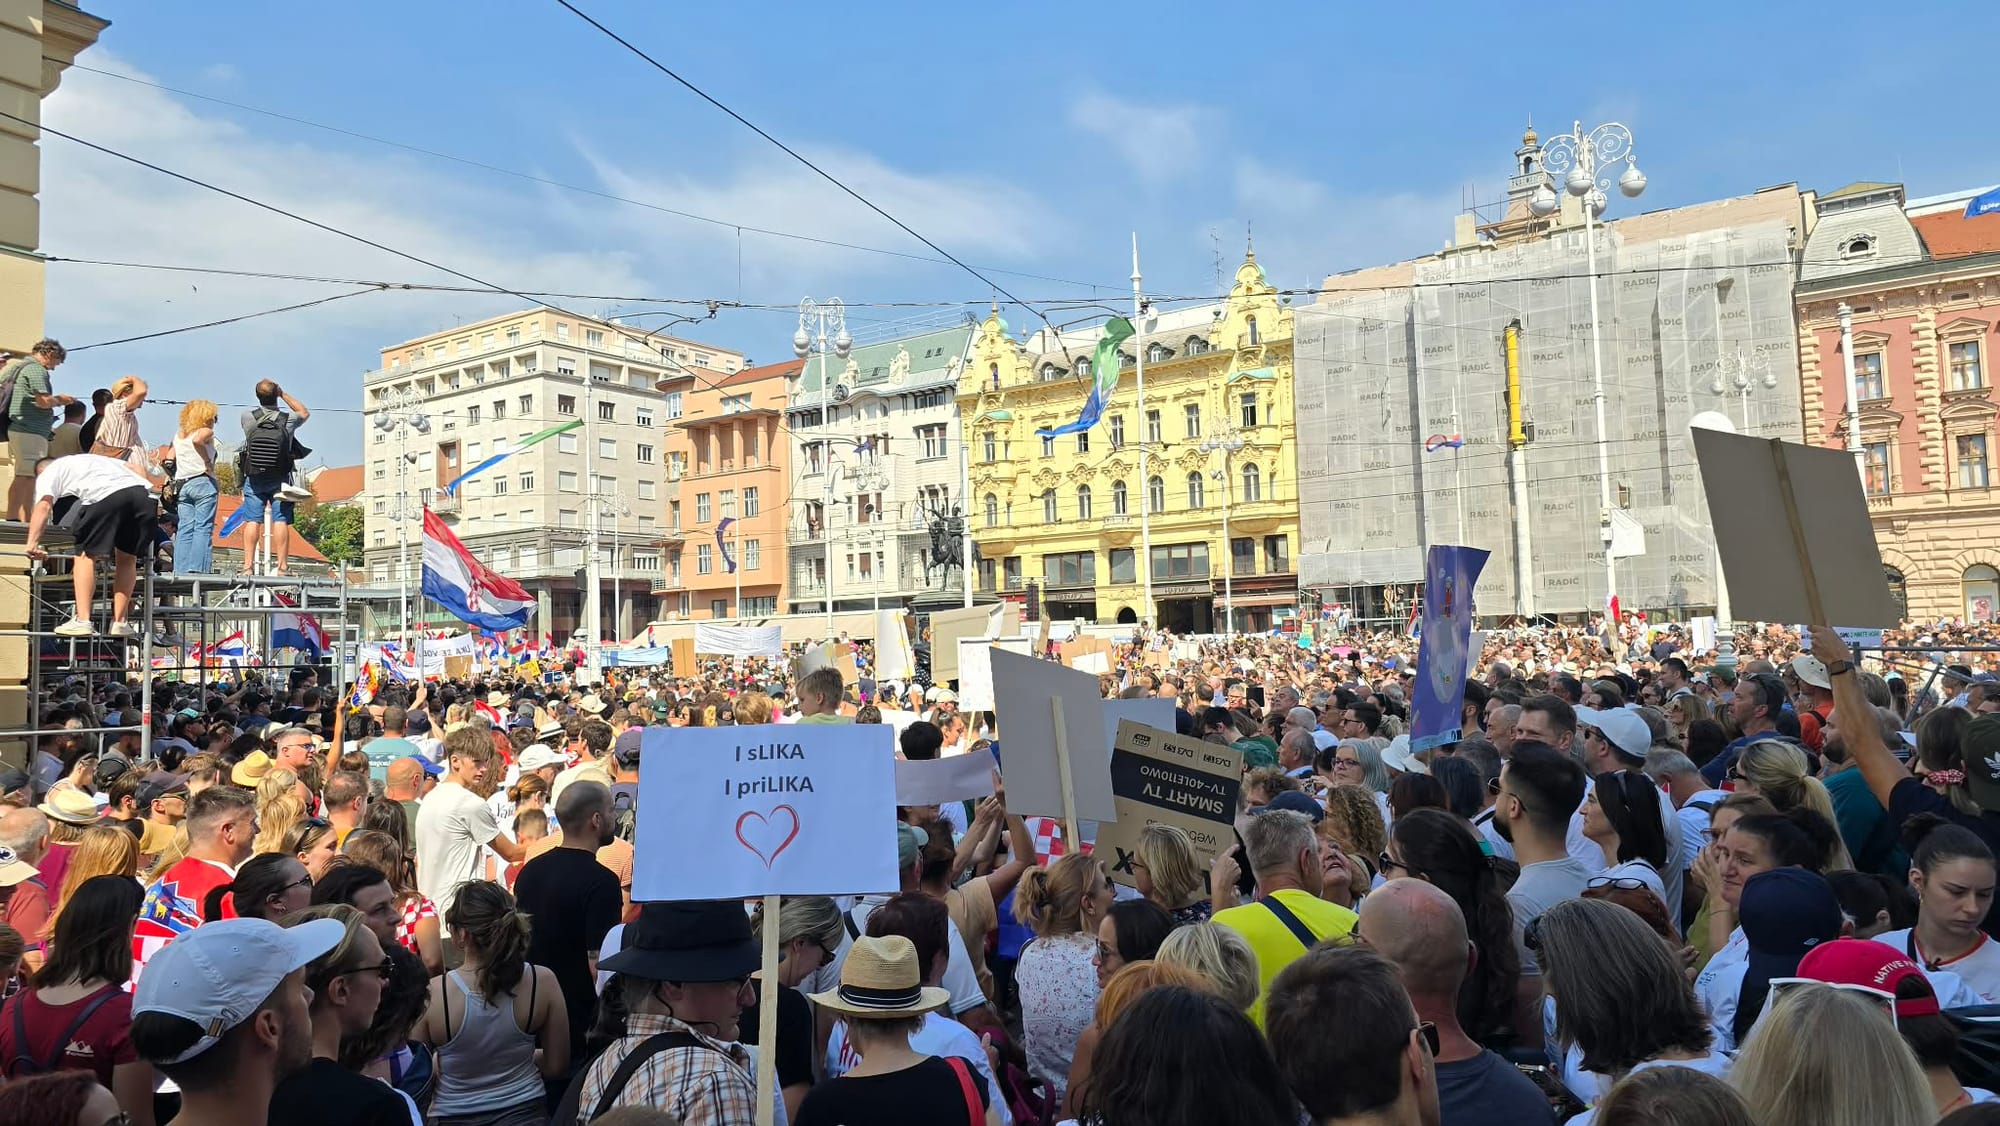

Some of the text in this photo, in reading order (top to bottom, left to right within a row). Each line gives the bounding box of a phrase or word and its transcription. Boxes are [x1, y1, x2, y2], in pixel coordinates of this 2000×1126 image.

[736, 744, 805, 761] I sLIKA
[725, 776, 814, 799] I priLIKA
[1142, 782, 1224, 814] SMART TV
[1873, 960, 1905, 985] NATIVE
